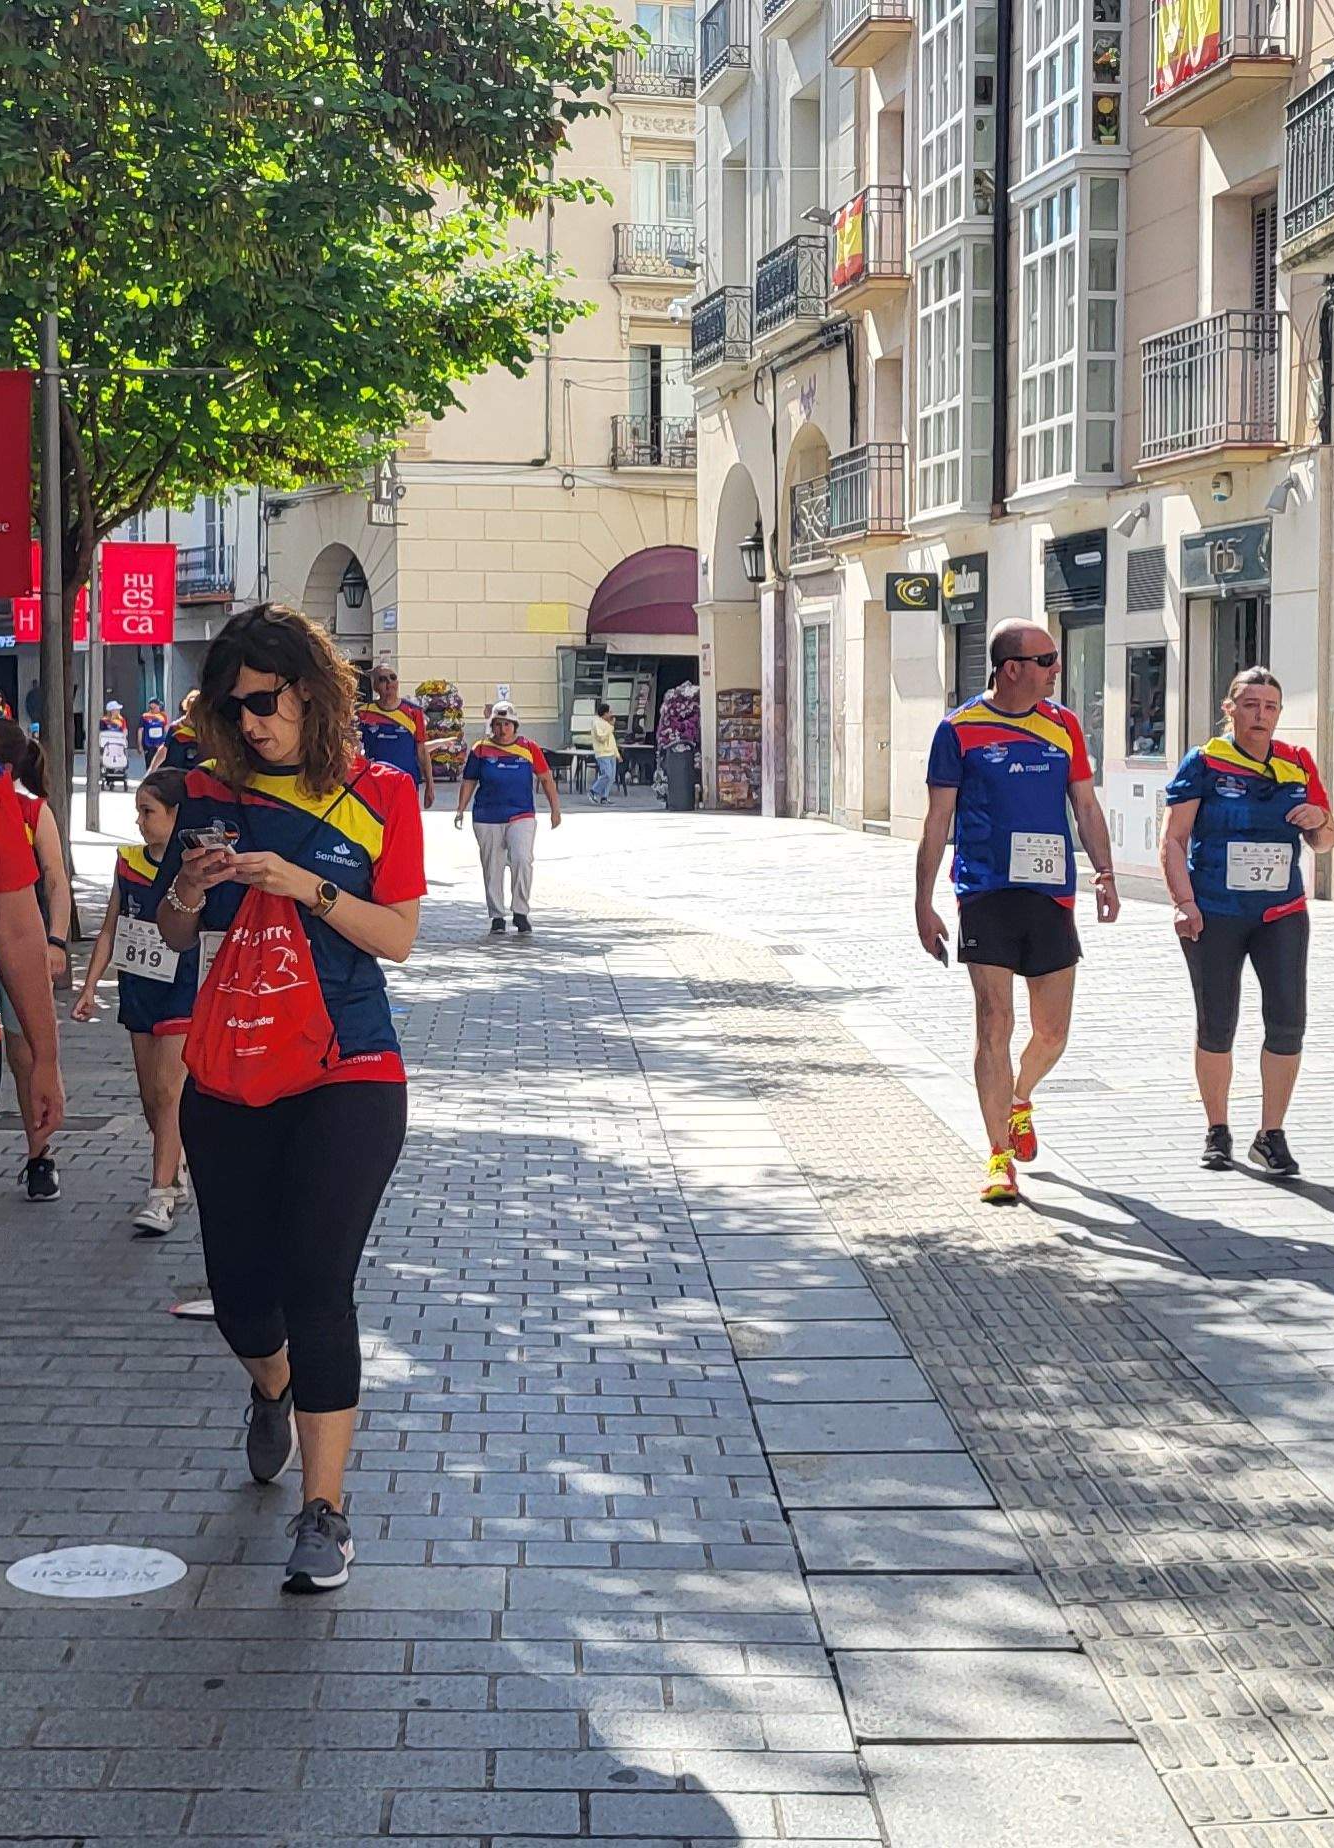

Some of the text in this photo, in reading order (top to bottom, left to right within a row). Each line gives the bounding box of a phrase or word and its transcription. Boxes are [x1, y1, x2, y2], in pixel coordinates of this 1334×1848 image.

[122, 588, 154, 608] es
[19, 608, 33, 631] H
[122, 615, 154, 634] ca
[314, 850, 362, 868] Santander
[1033, 857, 1054, 873] 38
[1250, 866, 1274, 882] 37
[126, 945, 162, 968] 819
[237, 1016, 275, 1029] Sannder
